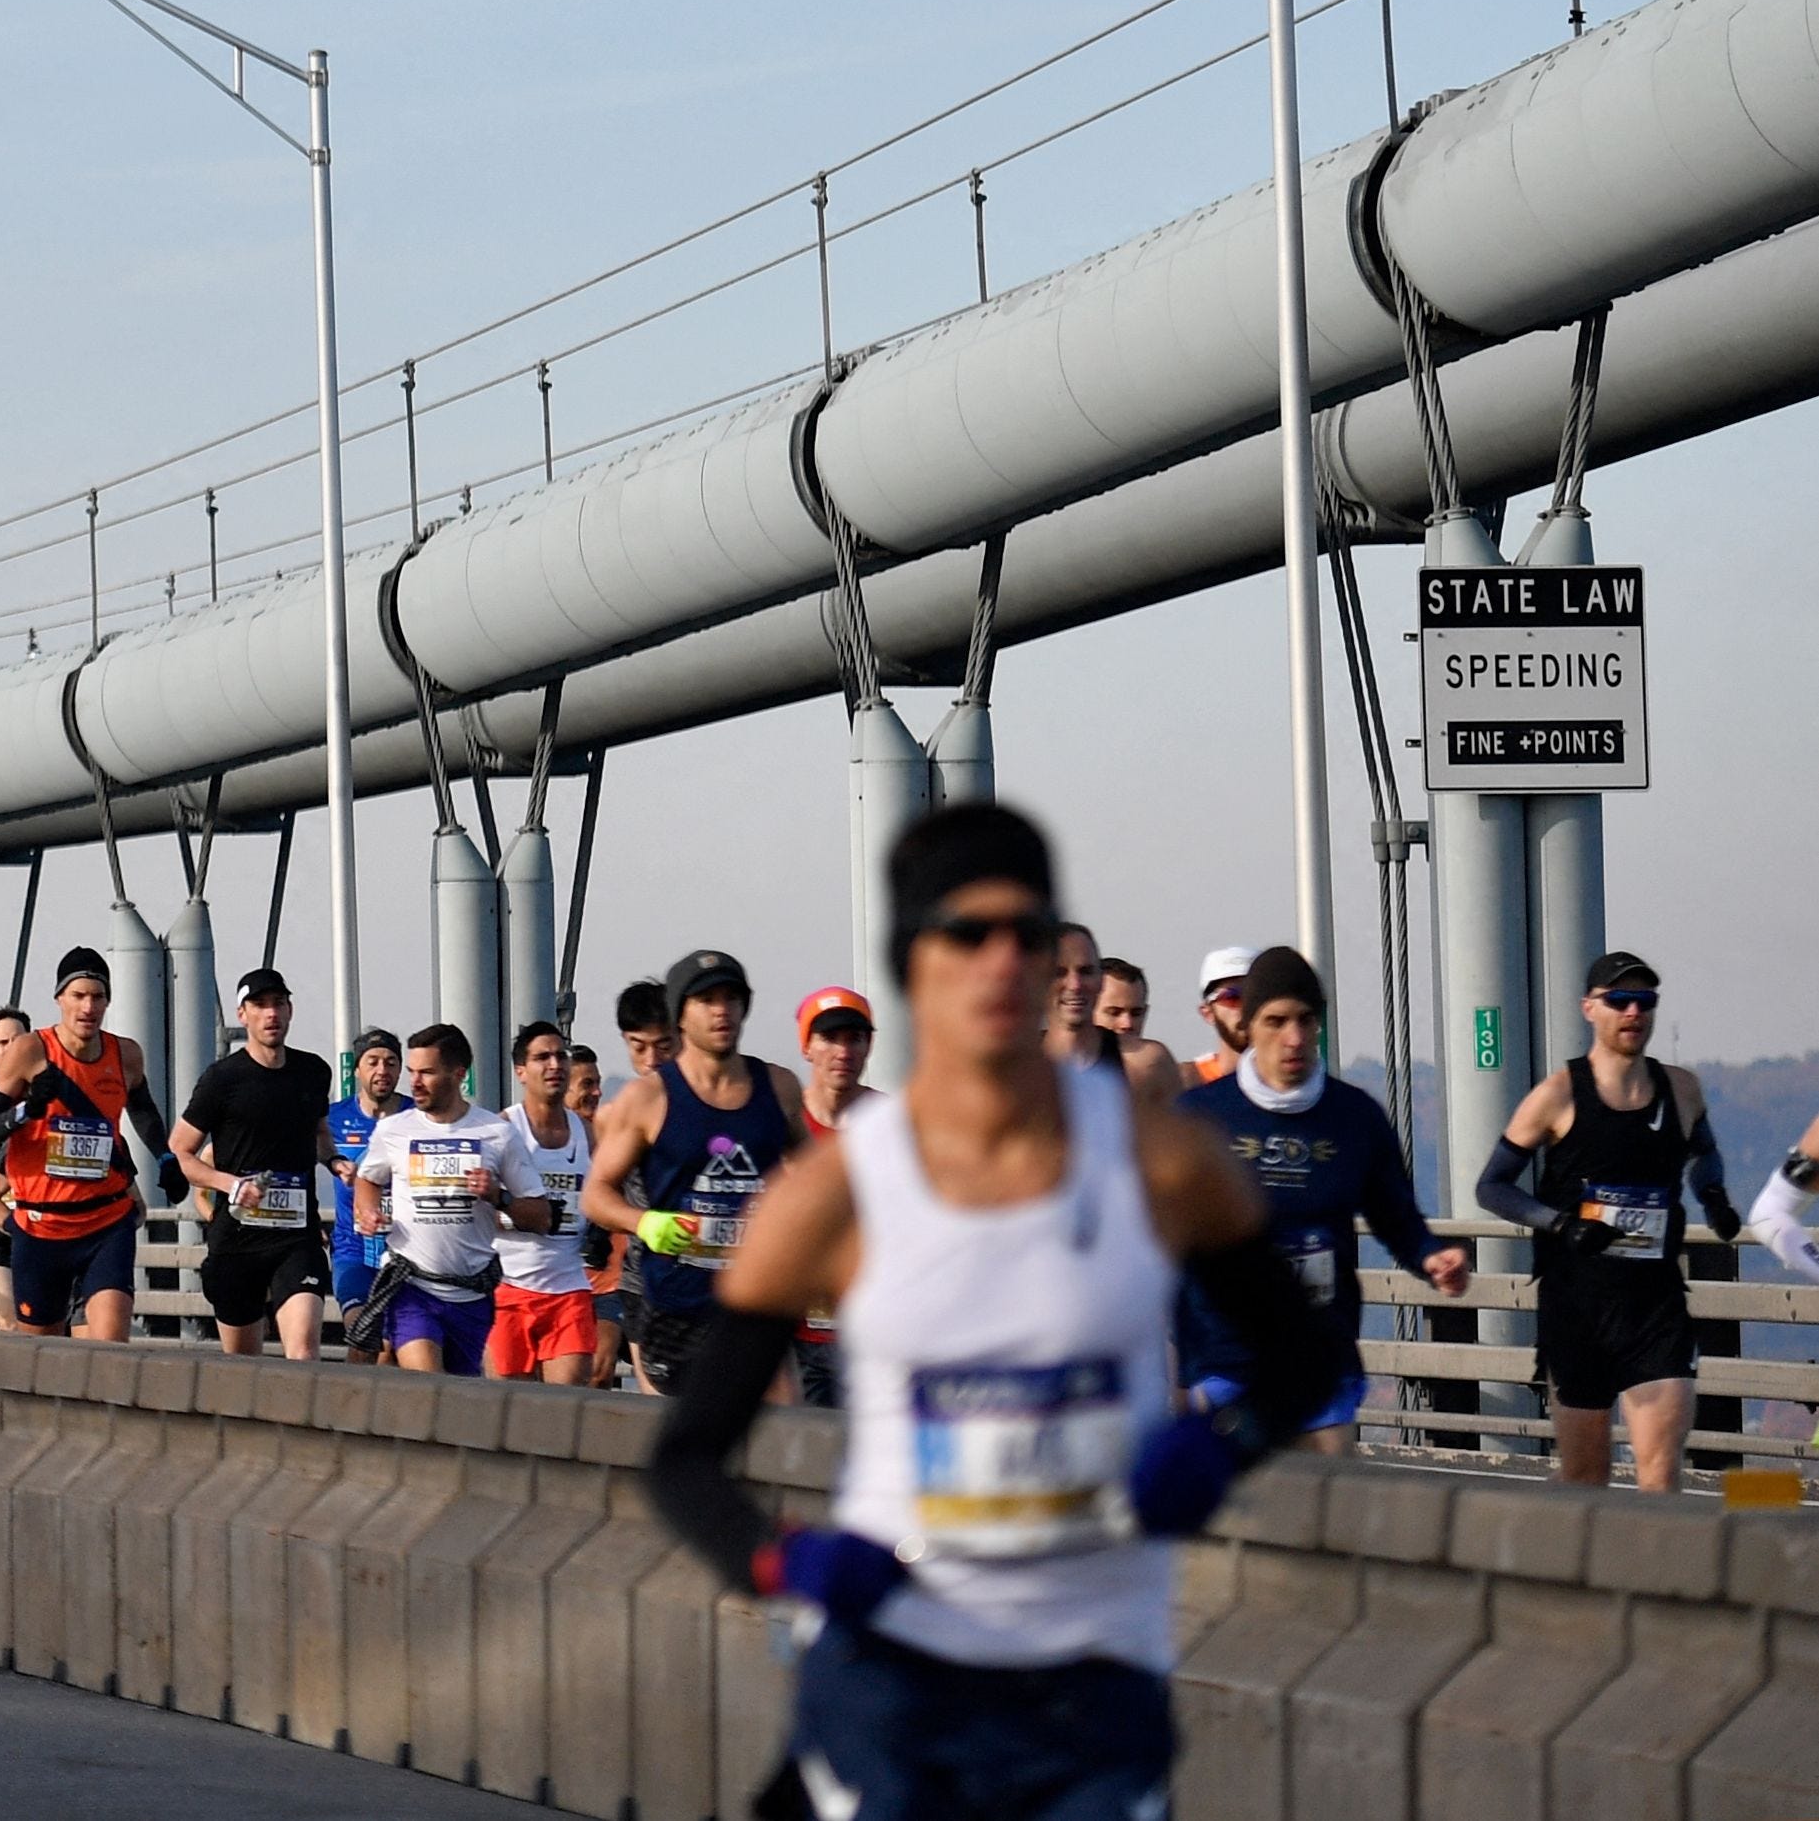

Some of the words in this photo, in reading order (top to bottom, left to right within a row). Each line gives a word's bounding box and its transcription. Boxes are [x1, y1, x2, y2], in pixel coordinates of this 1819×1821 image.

[1427, 578, 1537, 615] STATE
[1562, 578, 1635, 613] LAW
[1445, 653, 1623, 689] SPEEDING
[1456, 731, 1505, 755] FINE
[1519, 729, 1615, 755] +POINTS
[1480, 1010, 1496, 1067] 130
[70, 1136, 100, 1158] 3367
